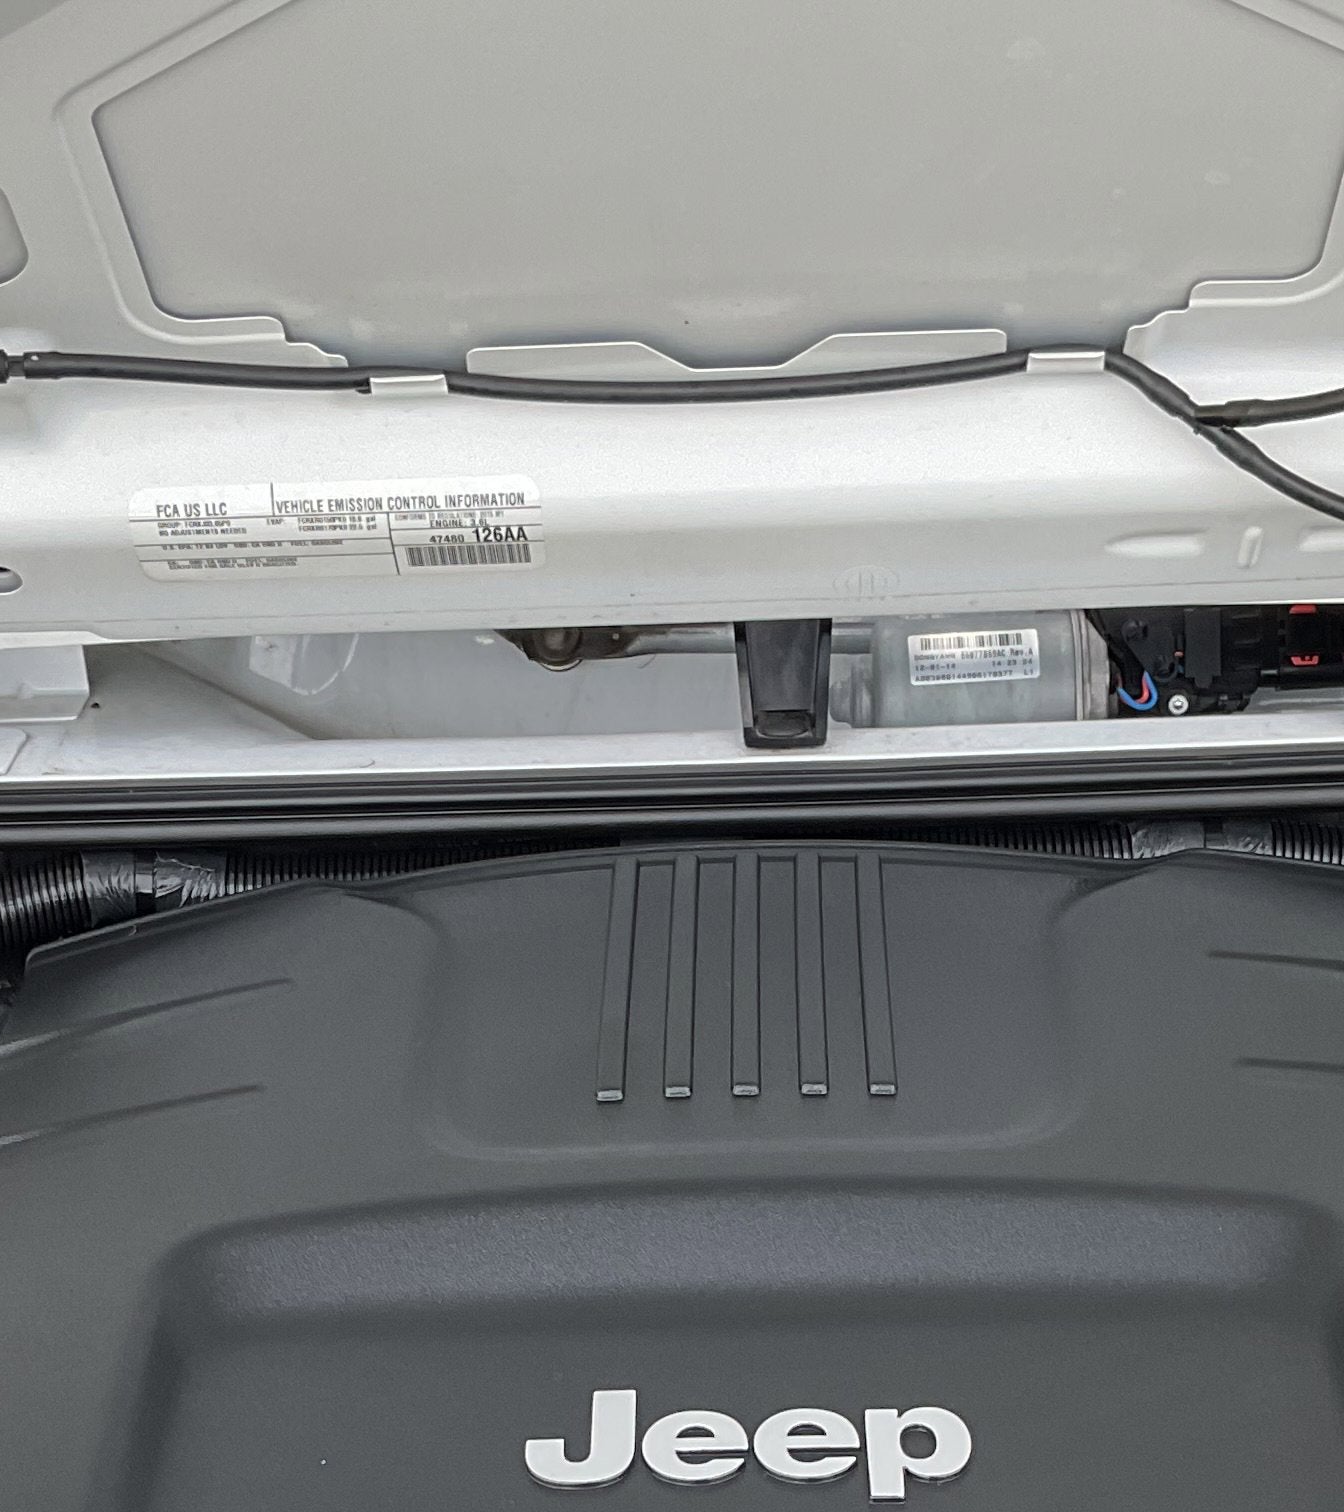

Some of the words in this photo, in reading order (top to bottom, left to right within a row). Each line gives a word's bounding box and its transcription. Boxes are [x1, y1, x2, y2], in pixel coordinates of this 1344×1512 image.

[156, 504, 180, 518] FCA
[184, 503, 201, 517] US
[205, 502, 227, 516] LLC
[276, 499, 324, 514] VEHICLE
[327, 497, 383, 512] EMISSION
[387, 495, 441, 510] CONTROL
[444, 492, 525, 508] INFORMATION
[471, 527, 528, 543] 126AA
[524, 1389, 972, 1504] Jeep
